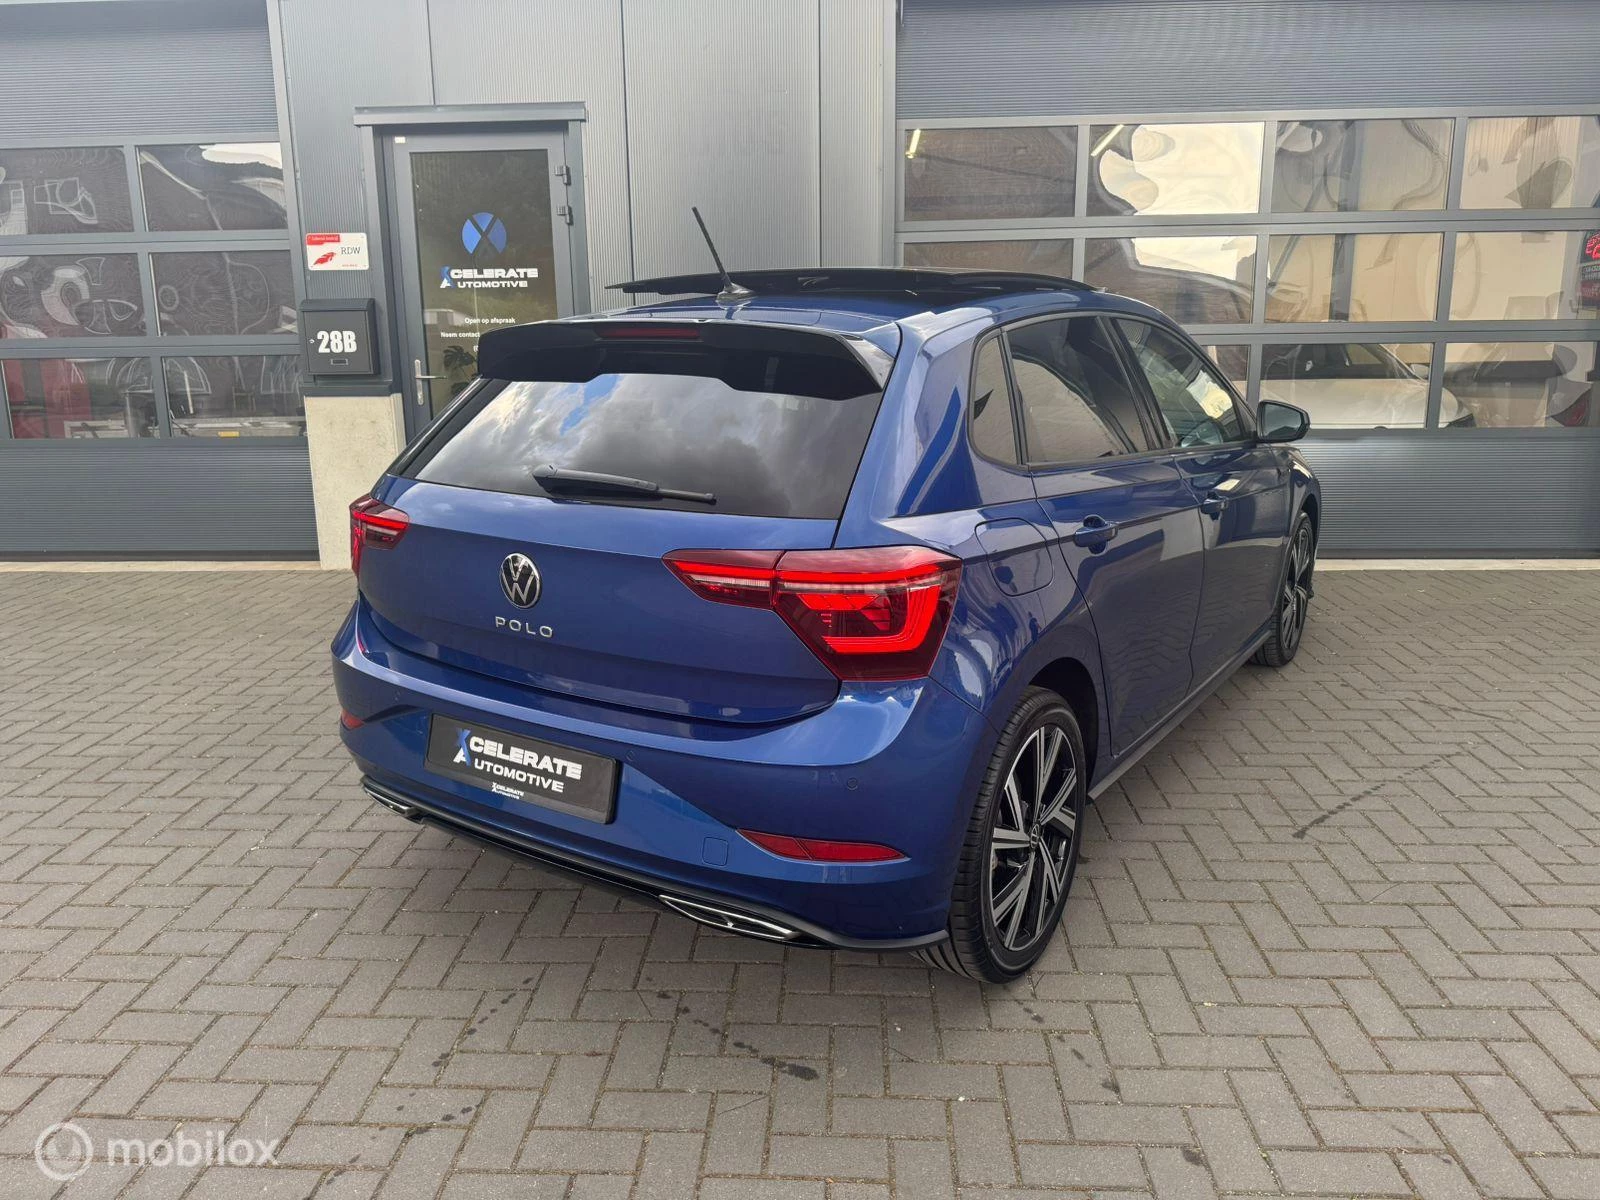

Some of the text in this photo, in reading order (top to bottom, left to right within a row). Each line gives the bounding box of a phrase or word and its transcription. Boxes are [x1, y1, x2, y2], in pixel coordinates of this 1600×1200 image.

[341, 246, 361, 255] RDW
[464, 317, 480, 325] Open
[490, 317, 516, 325] afspraak
[317, 330, 357, 353] 28B
[495, 616, 553, 638] POLO
[457, 728, 583, 780] XCELERATE
[453, 746, 565, 793] AUTOMOTIVE
